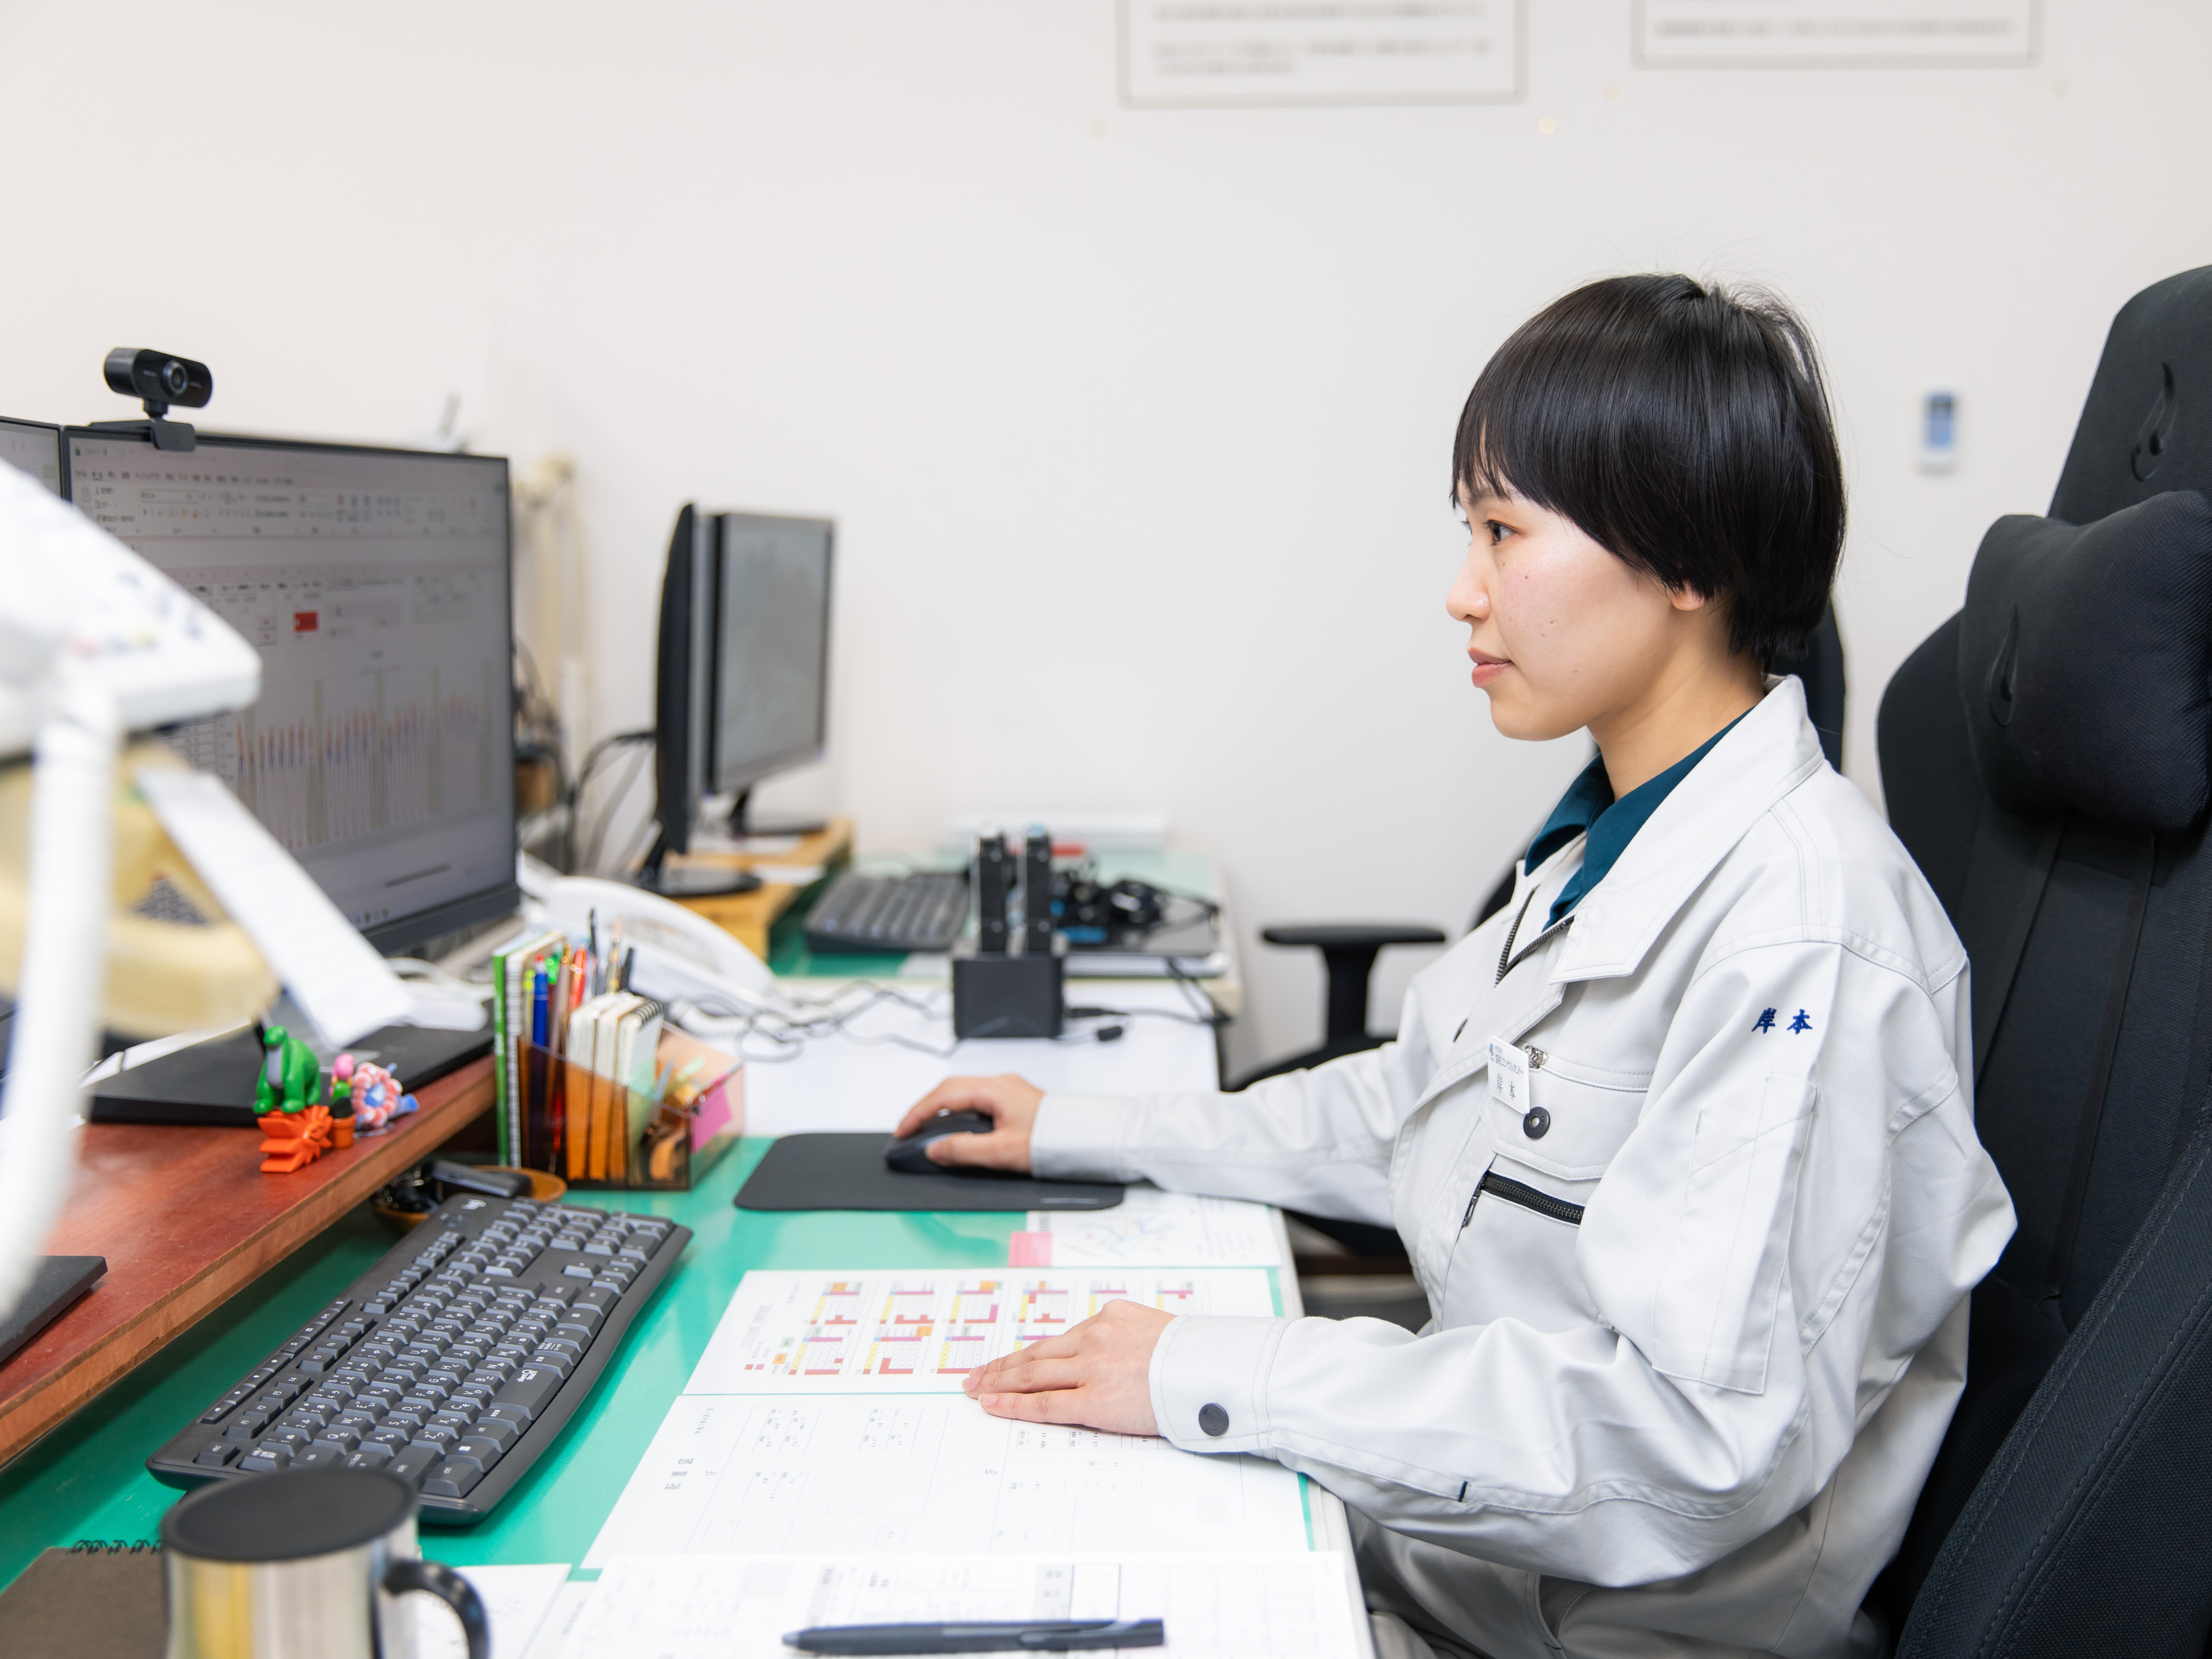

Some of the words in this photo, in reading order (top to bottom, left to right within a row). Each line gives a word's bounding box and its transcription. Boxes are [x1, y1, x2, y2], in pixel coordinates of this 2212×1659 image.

[1751, 1007, 1777, 1034] 岸
[1787, 1009, 1813, 1035] 本
[1497, 1073, 1503, 1093] 岸
[1509, 1081, 1515, 1100] 本
